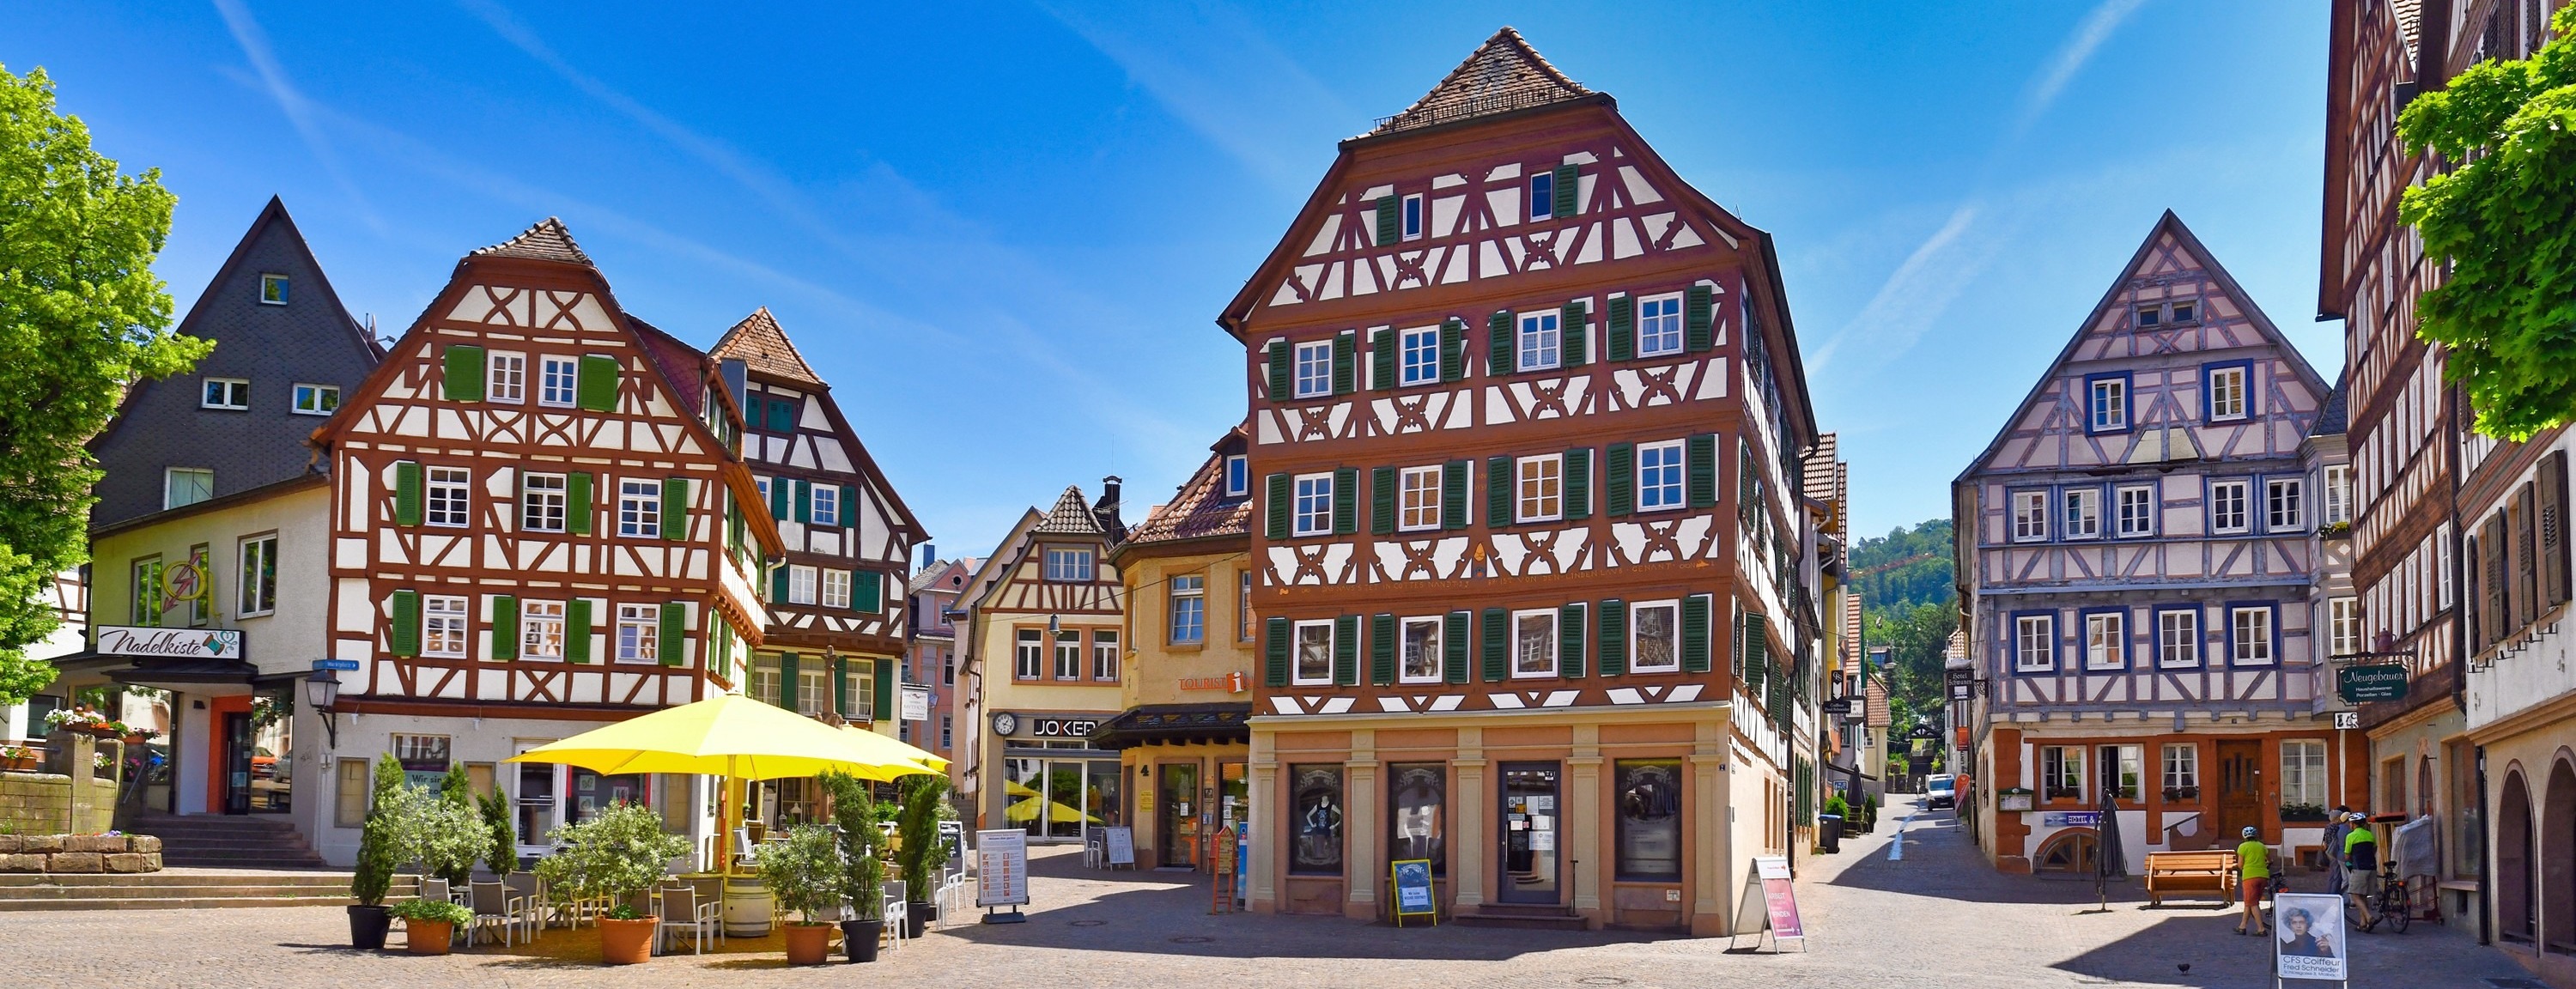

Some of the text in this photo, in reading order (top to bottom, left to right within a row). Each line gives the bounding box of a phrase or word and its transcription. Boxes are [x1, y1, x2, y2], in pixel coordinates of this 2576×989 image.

[100, 629, 201, 655] Nadelkiste
[2344, 670, 2403, 684] Neugebauer
[1178, 677, 1225, 689] TOURIST
[1140, 764, 1150, 777] 4
[411, 774, 428, 783] Wir
[2068, 815, 2095, 824] HOTEL &
[2282, 956, 2341, 967] CFS Coiffeur
[2301, 964, 2340, 973] Schneider
